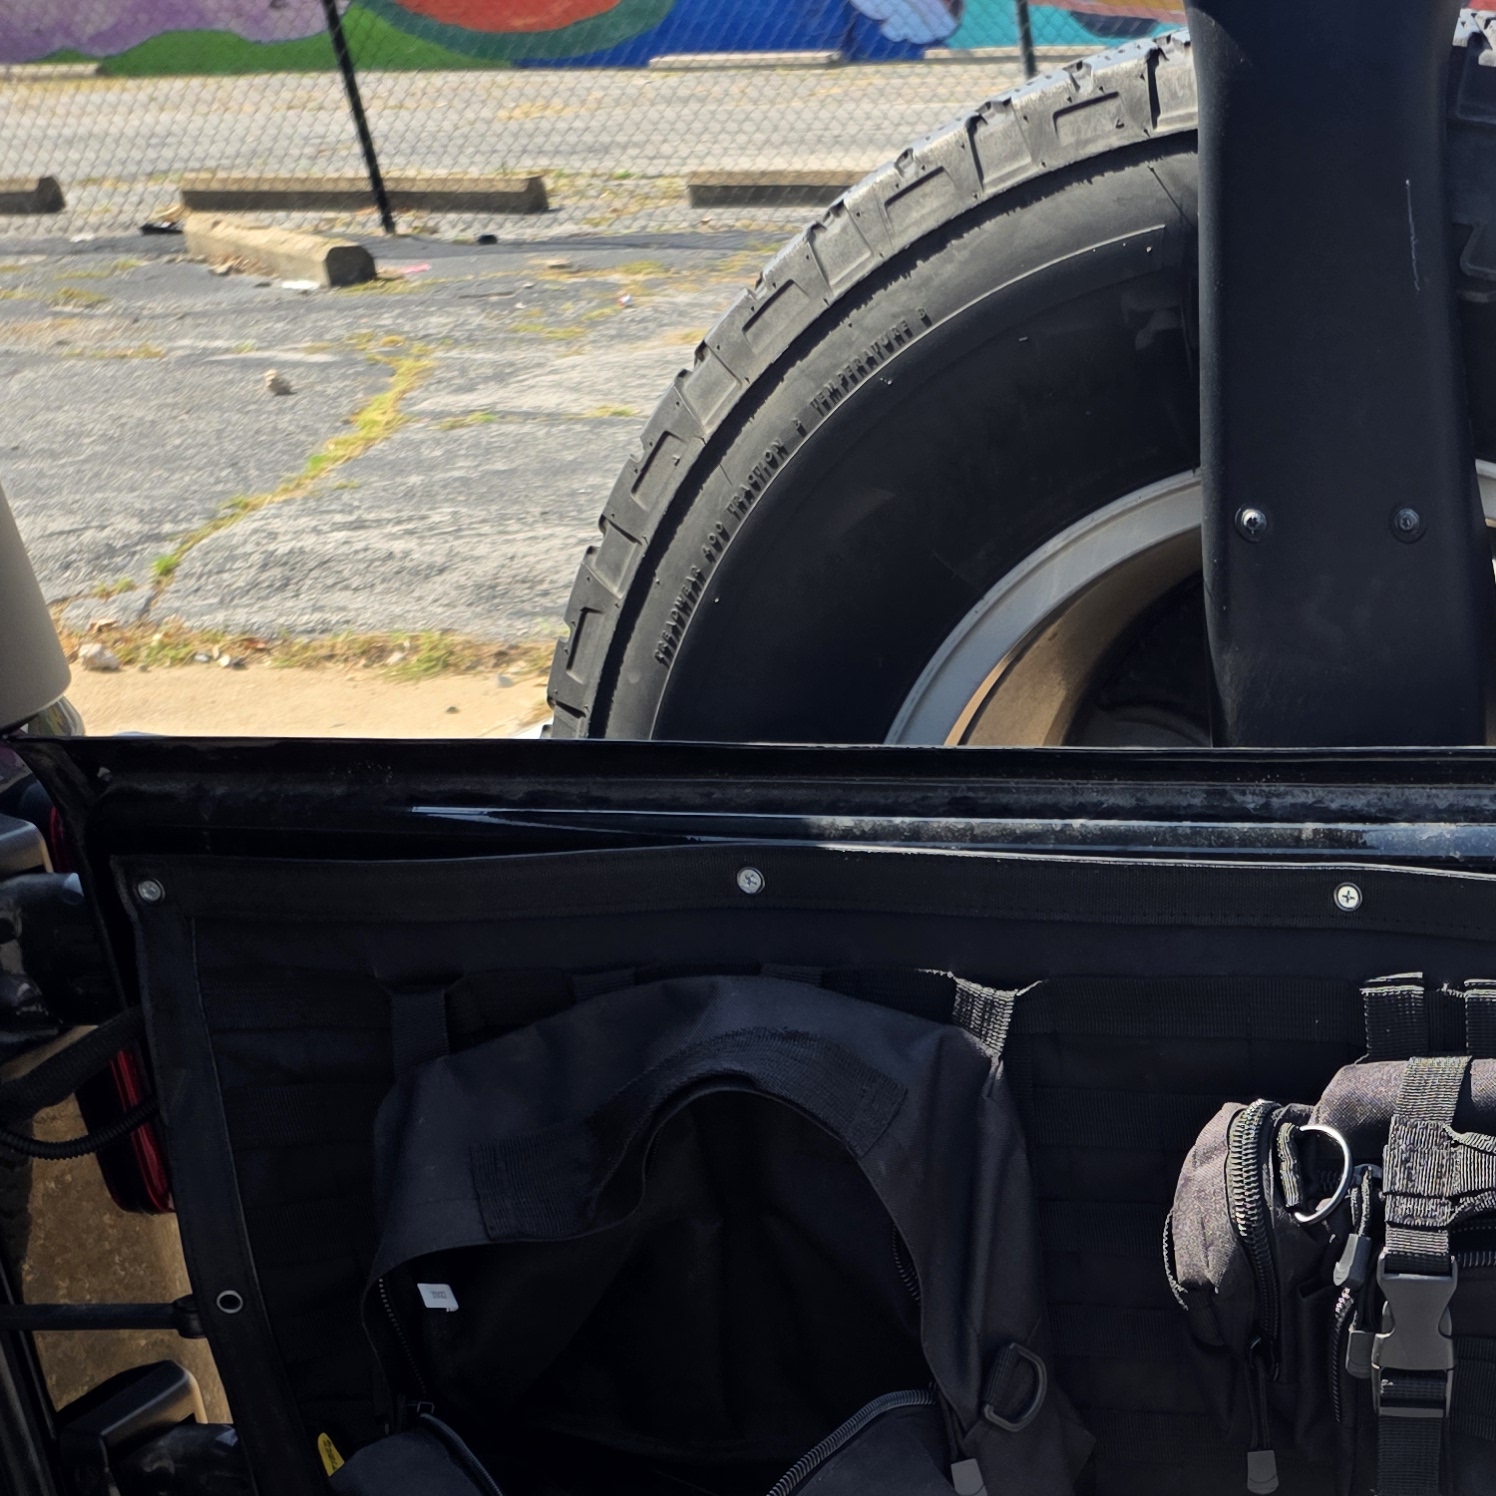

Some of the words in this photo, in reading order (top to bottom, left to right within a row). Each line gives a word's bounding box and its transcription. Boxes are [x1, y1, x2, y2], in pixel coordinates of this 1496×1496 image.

[655, 564, 704, 668] TREADWEAR
[726, 439, 788, 520] TRACTION
[810, 320, 913, 416] TEMPERATURE
